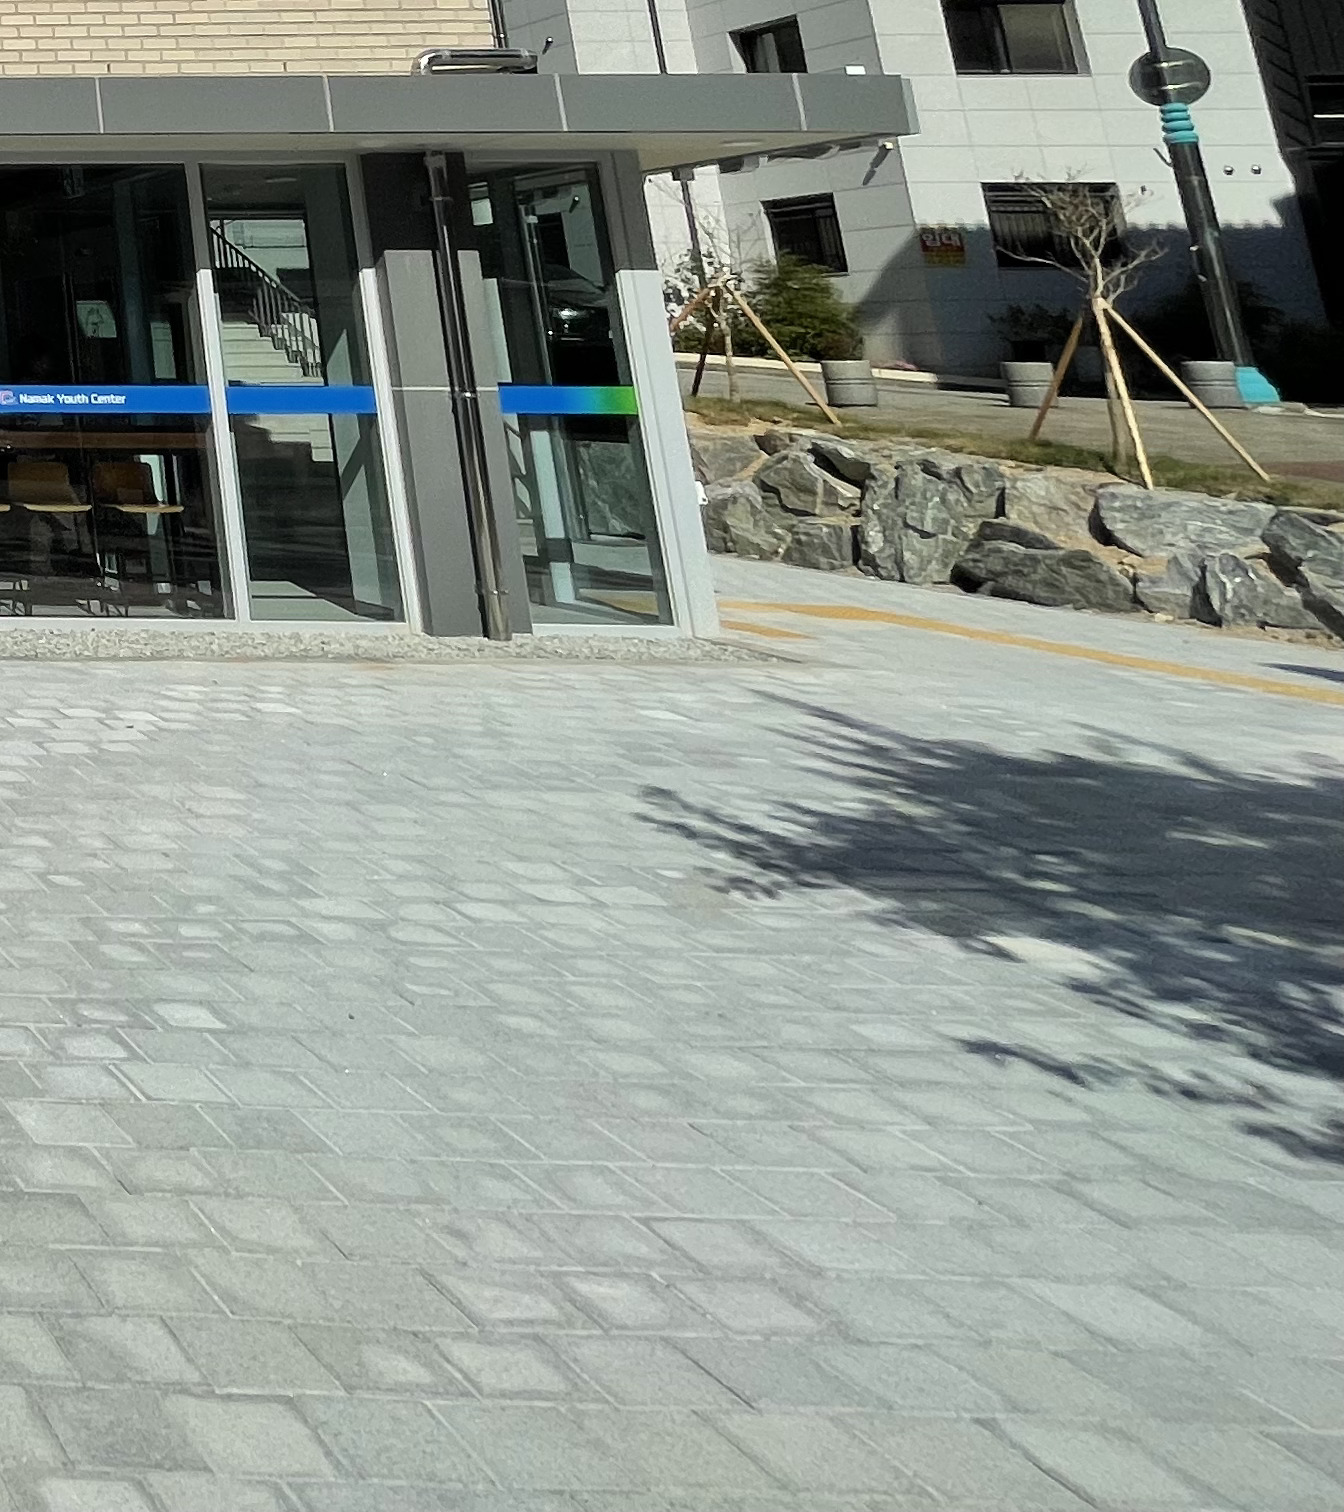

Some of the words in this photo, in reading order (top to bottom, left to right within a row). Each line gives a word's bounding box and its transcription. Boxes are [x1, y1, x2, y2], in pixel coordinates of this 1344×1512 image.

[19, 393, 54, 404] Namak
[56, 393, 89, 404] Youth
[90, 393, 126, 405] Center
